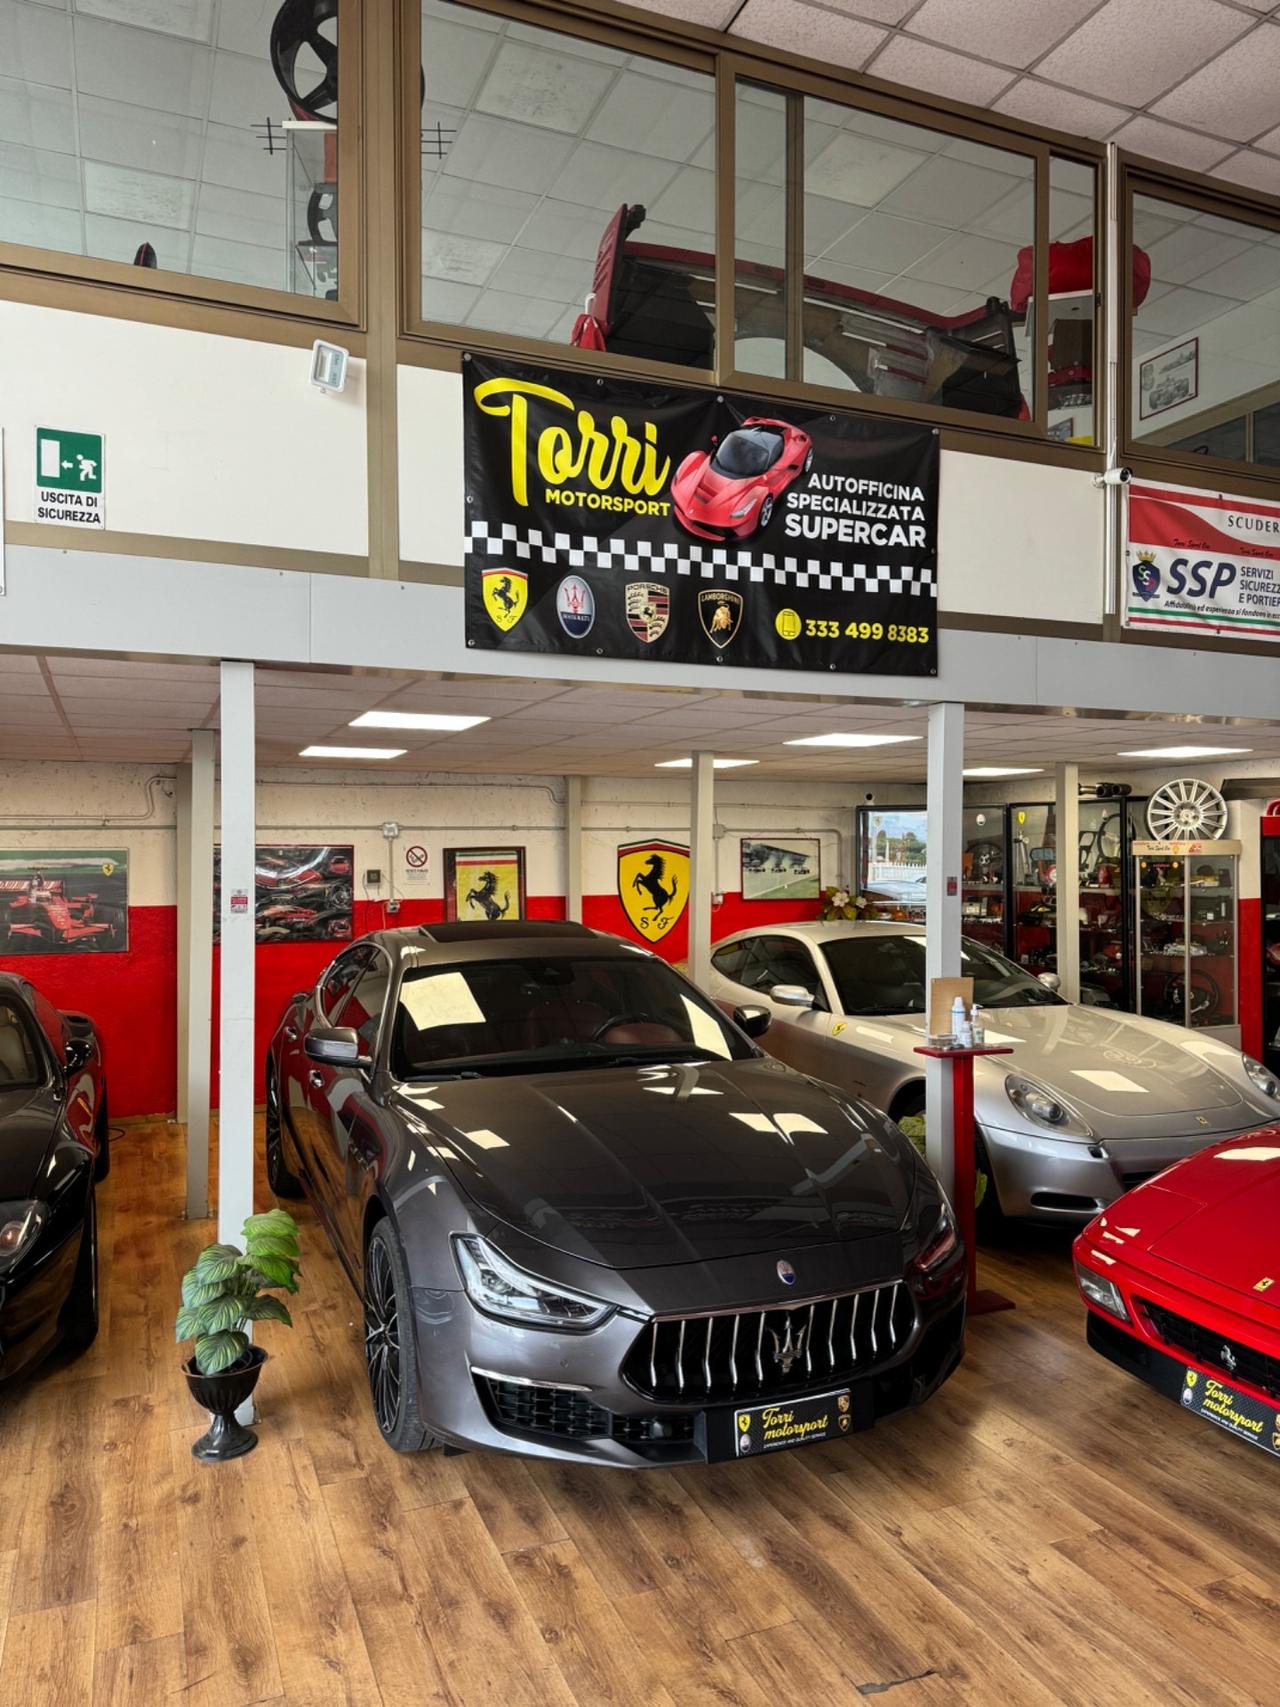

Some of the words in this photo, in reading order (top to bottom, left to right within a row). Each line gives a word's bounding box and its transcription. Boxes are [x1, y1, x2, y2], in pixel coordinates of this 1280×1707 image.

[473, 377, 671, 507] Torri
[41, 491, 83, 506] USCITA
[86, 496, 98, 507] DI
[808, 473, 925, 502] AUTOFFICINA
[37, 507, 101, 524] SICUREZZA
[545, 488, 671, 516] MOTORSPORT
[786, 493, 926, 521] SPECIALIZZATA
[784, 514, 927, 548] SUPERCAR
[1166, 557, 1237, 599] SSP
[1240, 566, 1274, 580] SERVIZI
[1239, 593, 1245, 604] E
[806, 619, 839, 638] 333
[844, 622, 884, 640] 499
[887, 624, 930, 644] 8383
[639, 917, 650, 929] S
[1204, 1379, 1234, 1406] Torri
[762, 1407, 794, 1429] Torri
[764, 1414, 829, 1441] motorsport
[1203, 1398, 1264, 1433] motorsport
